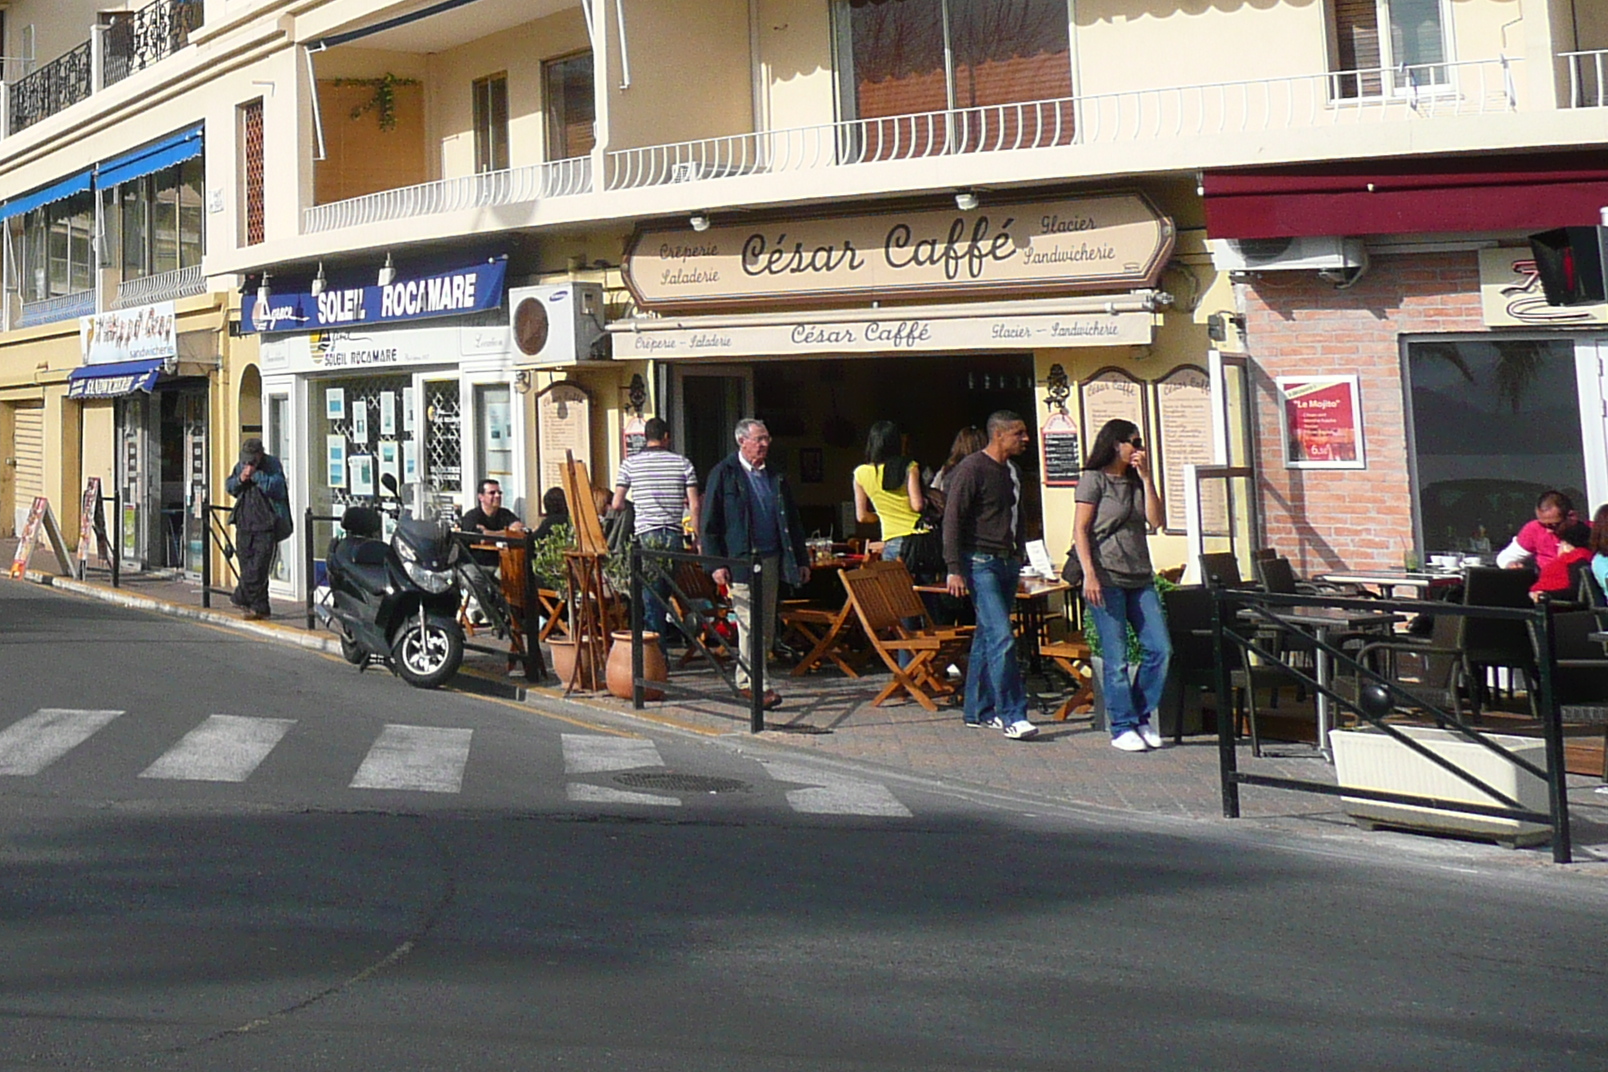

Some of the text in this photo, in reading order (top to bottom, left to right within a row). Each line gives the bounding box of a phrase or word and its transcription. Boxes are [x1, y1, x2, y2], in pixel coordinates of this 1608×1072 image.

[1041, 215, 1098, 234] Glacier
[741, 215, 1017, 280] César Caffé
[1022, 243, 1116, 265] Sandwicherie
[660, 269, 720, 285] Saladerie
[317, 288, 366, 324] SOLEIL
[381, 272, 477, 318] ROCAMARE
[791, 320, 932, 347] César Caffé
[991, 321, 1119, 339] Glacier Sandwicherie
[689, 334, 732, 348] Saladerie
[324, 353, 347, 367] SOLEIL
[351, 348, 397, 364] ROCAMARE
